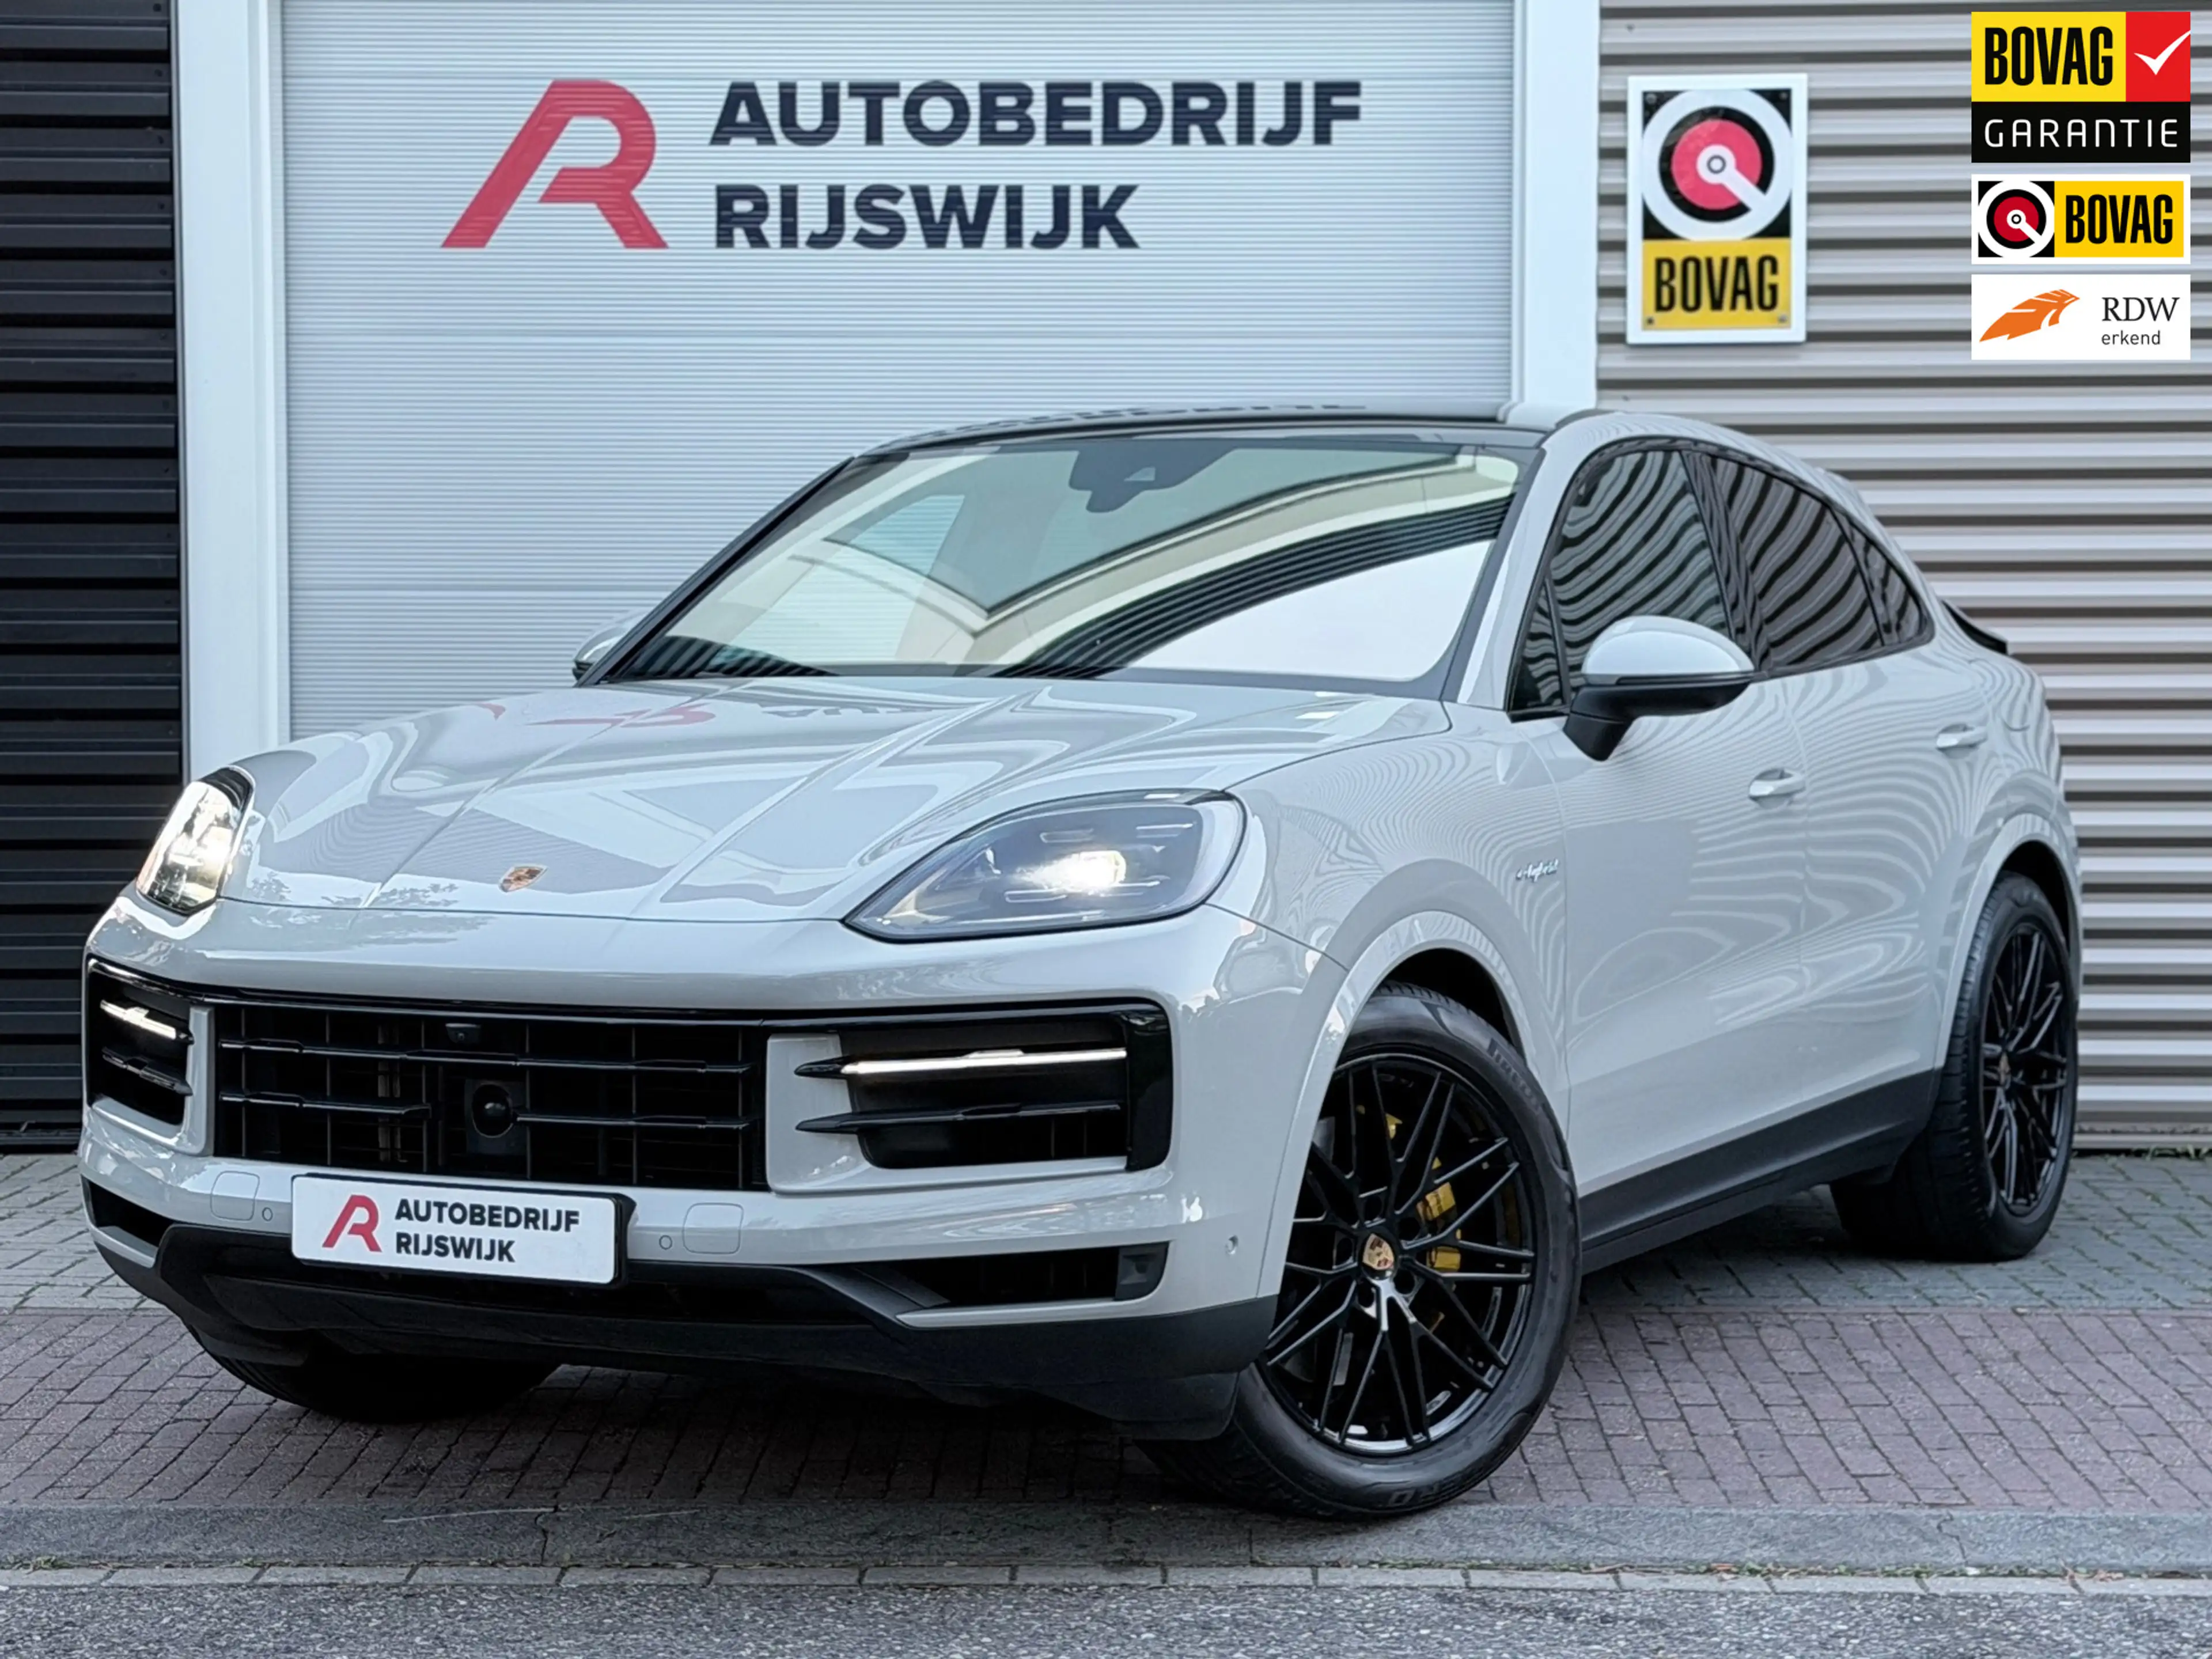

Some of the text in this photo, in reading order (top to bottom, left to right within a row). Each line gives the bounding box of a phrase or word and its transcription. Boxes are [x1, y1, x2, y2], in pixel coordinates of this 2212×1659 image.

[710, 80, 1361, 146] AUTOBEDRIJF
[715, 184, 1139, 249] RIJSWIJK
[1655, 255, 1778, 313] BOVAG
[395, 1198, 579, 1233] AUTOBEDRIJF
[396, 1232, 516, 1263] RIJSWIJK
